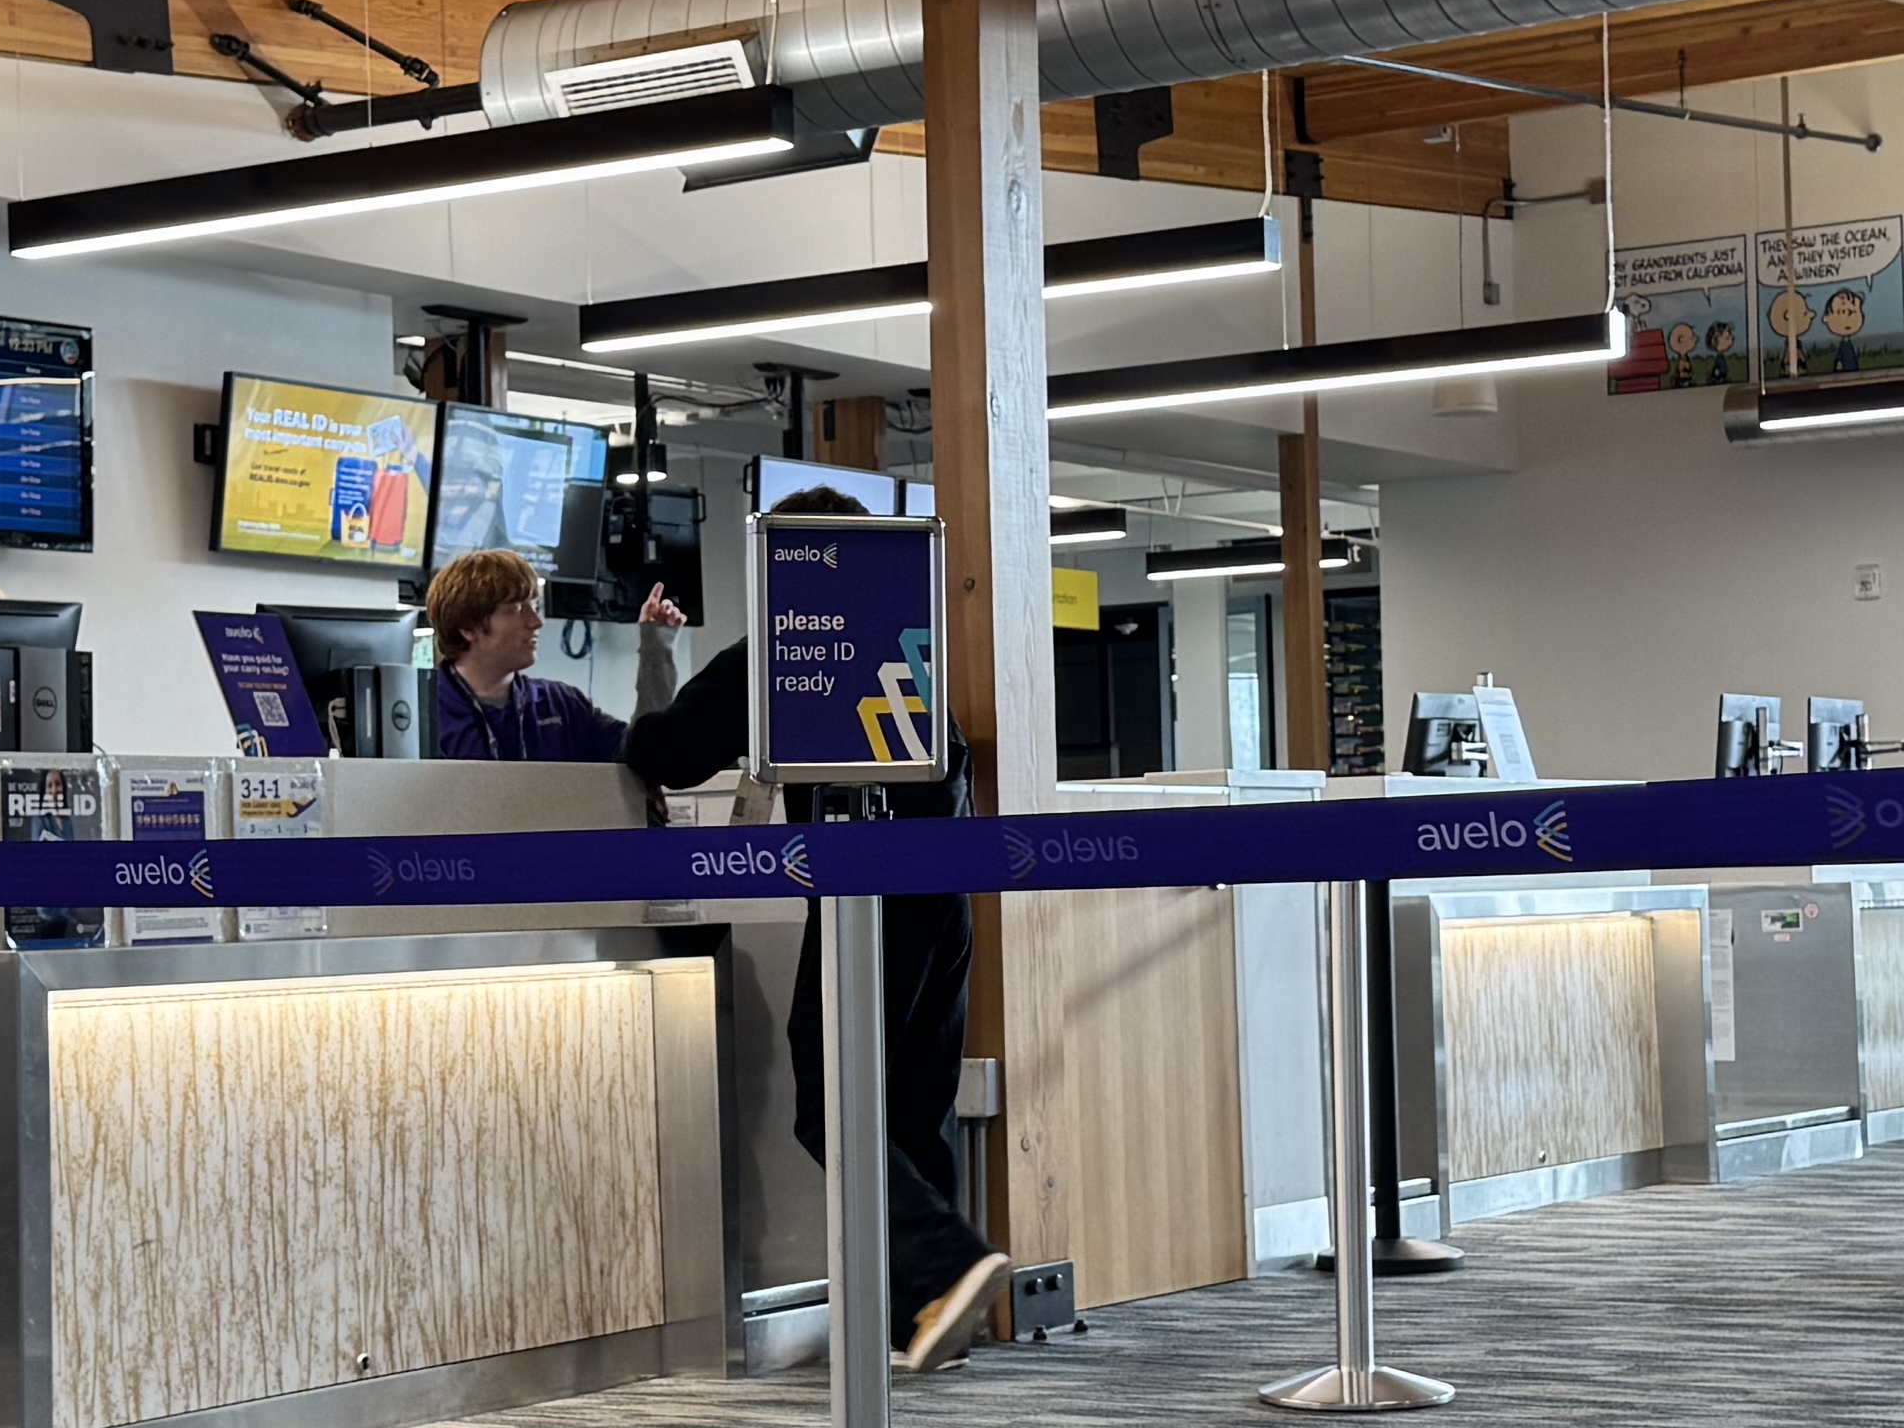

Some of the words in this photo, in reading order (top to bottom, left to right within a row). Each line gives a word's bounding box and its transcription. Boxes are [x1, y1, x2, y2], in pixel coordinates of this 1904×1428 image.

[1791, 236, 1816, 249] SAW
[1820, 233, 1840, 246] THE
[1845, 227, 1890, 243] OCEAN,
[1632, 253, 1708, 270] GRANDPARENTS
[1711, 248, 1736, 262] JUST
[1767, 255, 1786, 269] AN
[1797, 250, 1824, 264] THEY
[1828, 244, 1875, 260] VISITED
[1615, 274, 1627, 287] OT
[1631, 272, 1656, 286] BACK
[1659, 269, 1684, 283] FROM
[1778, 269, 1788, 282] A
[1794, 263, 1841, 280] WINERY
[274, 409, 310, 430] REAL
[312, 414, 328, 431] ID
[775, 545, 820, 562] avelo
[775, 610, 845, 635] please
[776, 640, 826, 661] have
[834, 642, 854, 660] ID
[776, 671, 835, 696] ready
[241, 779, 281, 799] 3-1-1
[8, 794, 72, 816] REAL
[73, 794, 96, 816] ID
[1417, 809, 1528, 853] avelo
[691, 842, 776, 876] avelo
[114, 854, 185, 887] avelo
